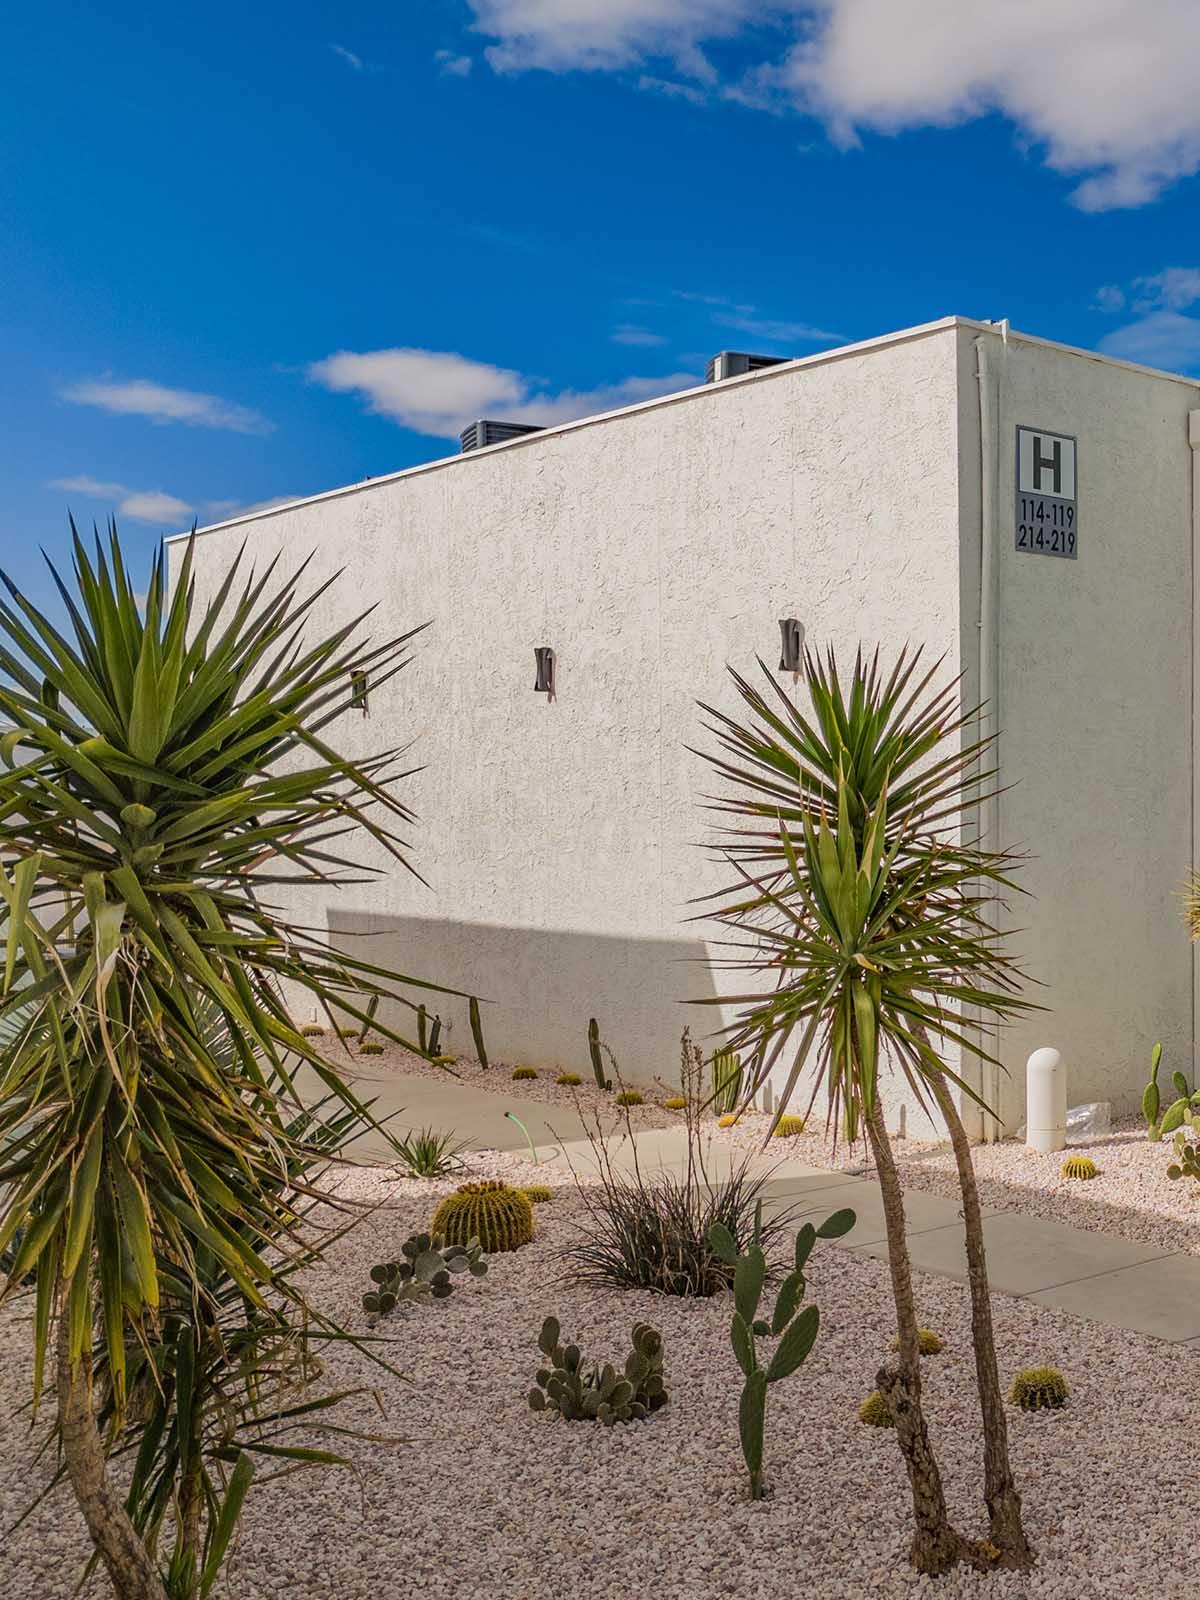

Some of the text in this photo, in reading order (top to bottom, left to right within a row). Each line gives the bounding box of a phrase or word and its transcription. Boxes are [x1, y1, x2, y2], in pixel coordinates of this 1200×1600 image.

[1033, 436, 1061, 493] H
[1022, 499, 1074, 528] 114-119
[1019, 525, 1075, 553] 214-219
